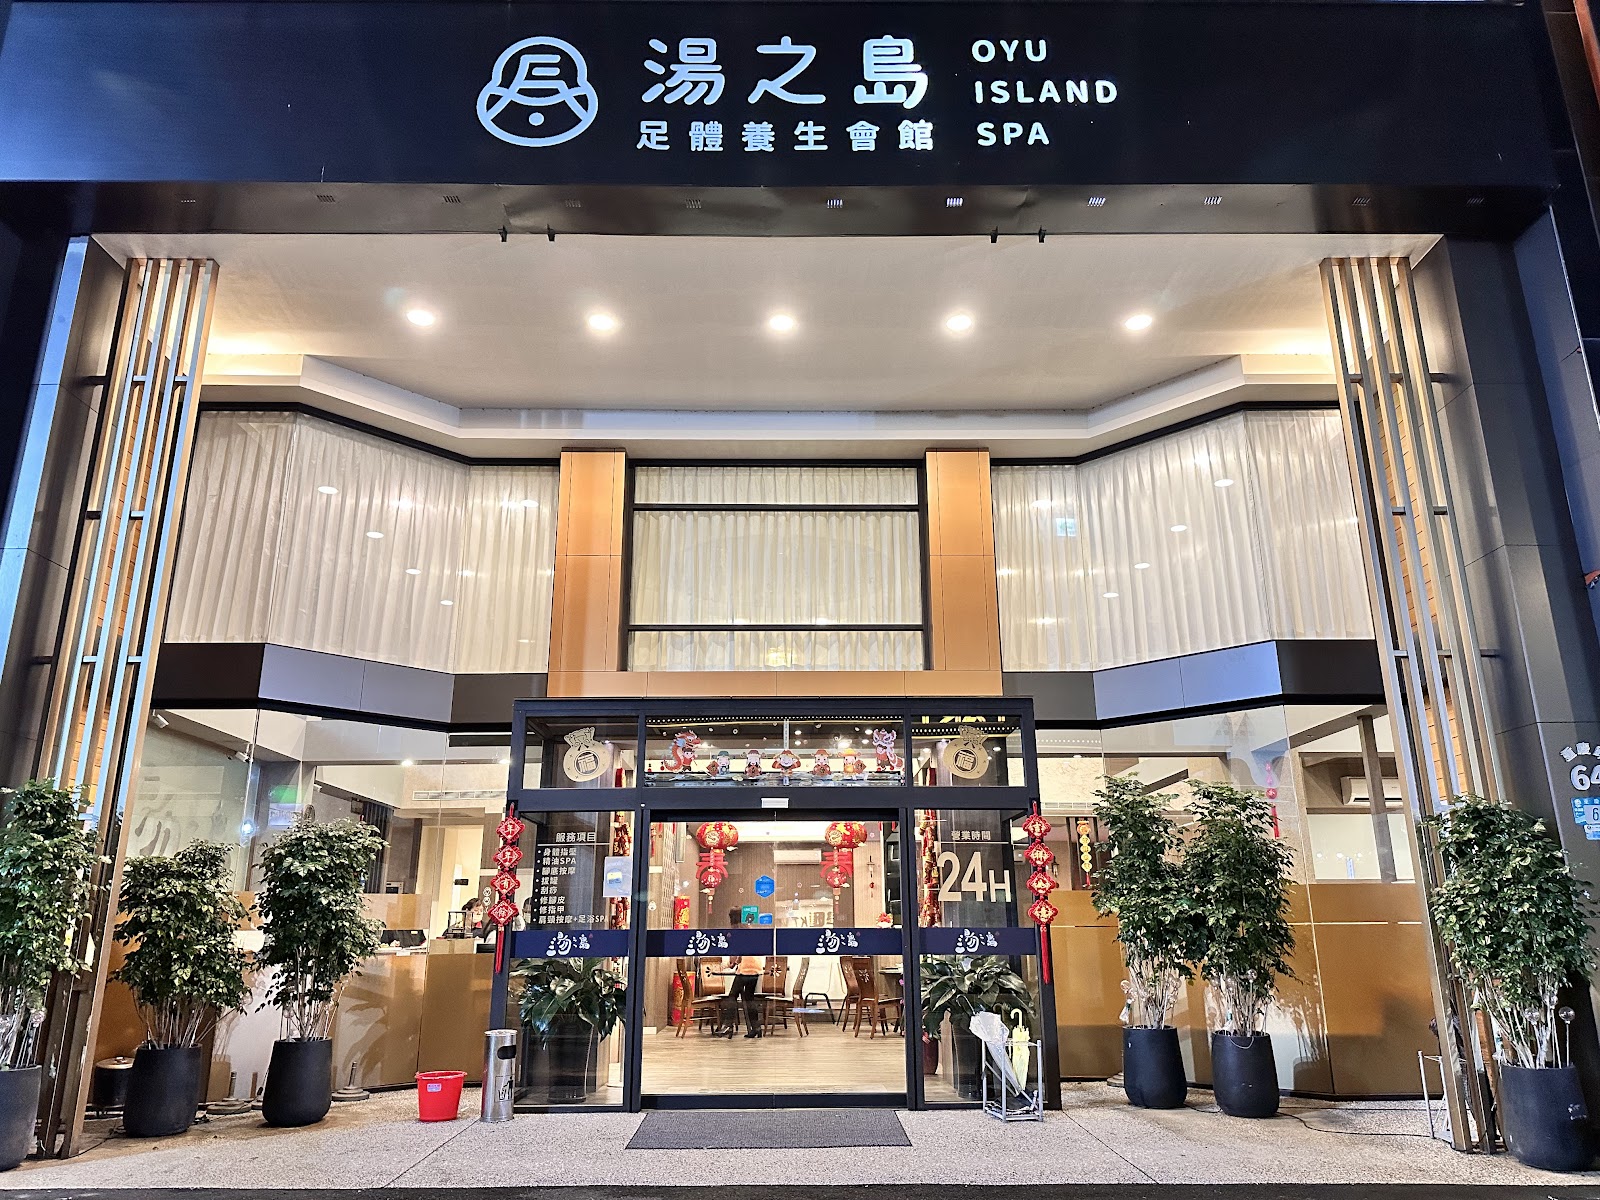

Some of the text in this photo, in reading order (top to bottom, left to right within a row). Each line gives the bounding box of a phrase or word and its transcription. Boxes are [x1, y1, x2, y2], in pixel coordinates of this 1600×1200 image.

[971, 39, 1047, 63] OYU
[641, 35, 928, 109] 湯之島
[974, 79, 1118, 104] ISLAND
[636, 118, 934, 152] 足體養生會館
[976, 121, 1050, 147] SPA
[555, 831, 596, 843] 服務項目
[950, 830, 991, 841] 營業時間
[937, 851, 1012, 903] 24H
